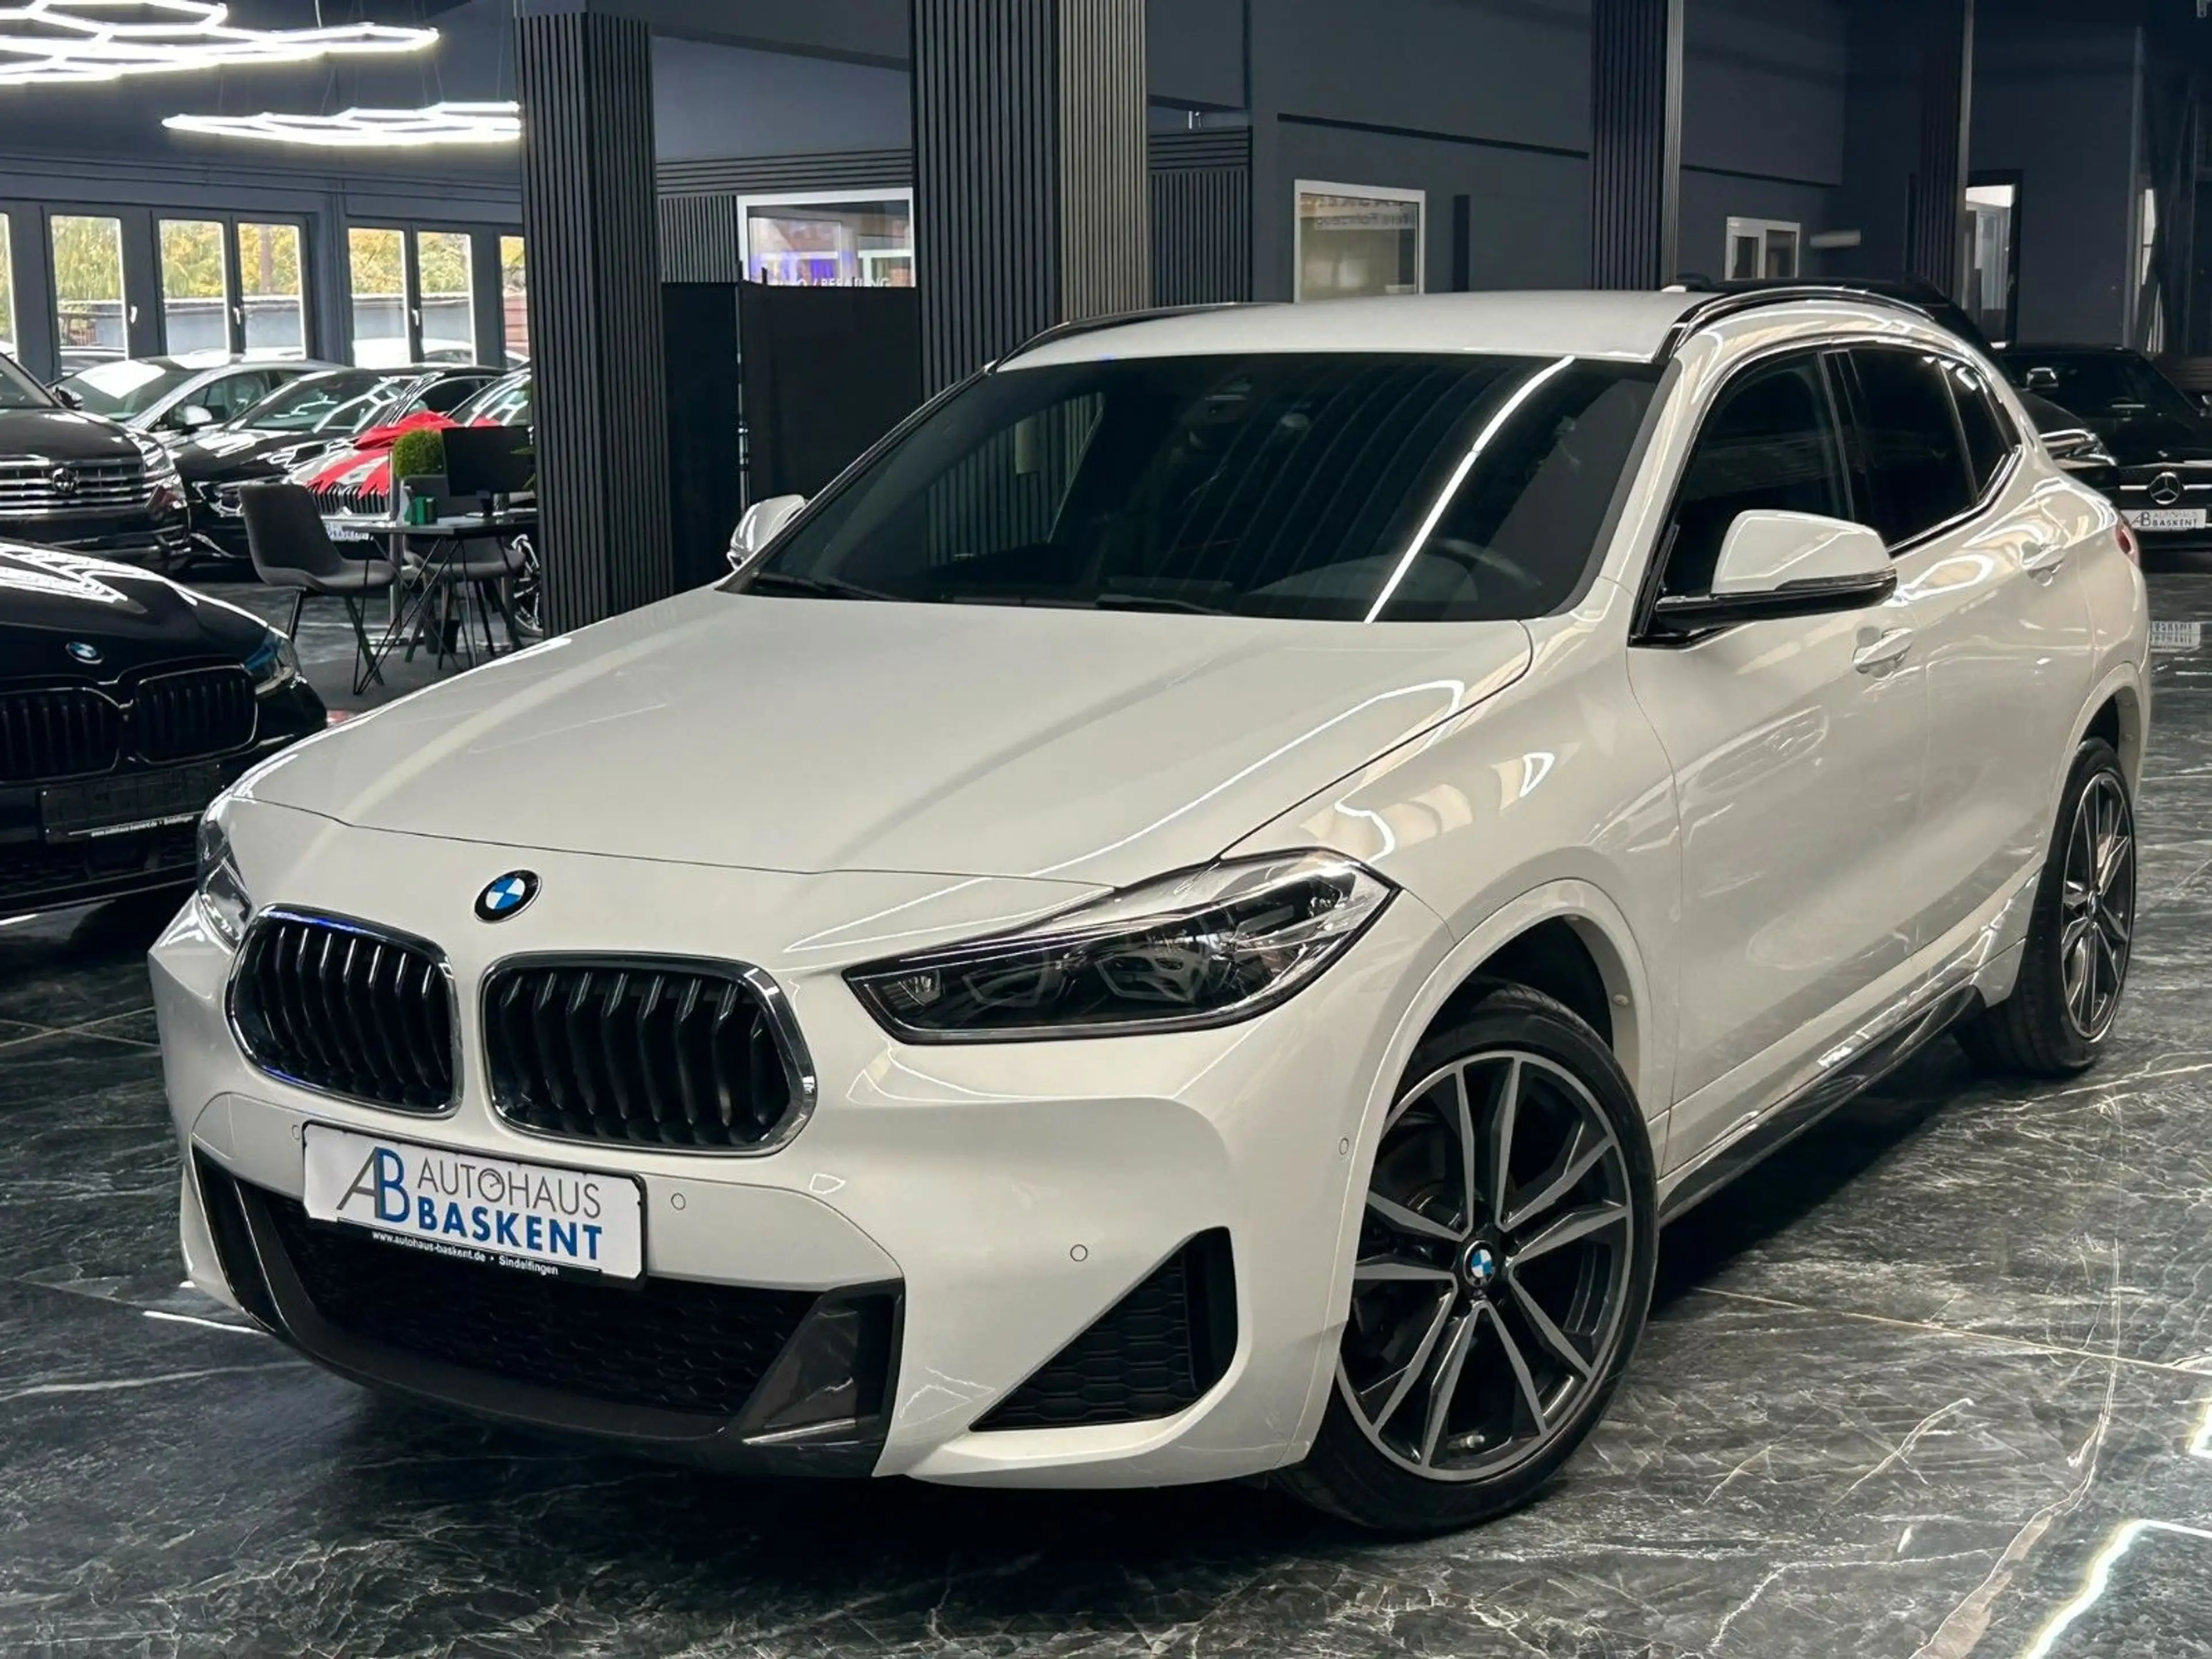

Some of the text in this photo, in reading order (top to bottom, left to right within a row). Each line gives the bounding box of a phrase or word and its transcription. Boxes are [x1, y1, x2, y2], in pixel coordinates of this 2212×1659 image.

[336, 1146, 410, 1223] AB
[418, 1157, 601, 1219] AUTOHAUS
[372, 1230, 559, 1276] www.autohaus-baskent.de Sindelfingen
[418, 1195, 603, 1260] BASKENT
